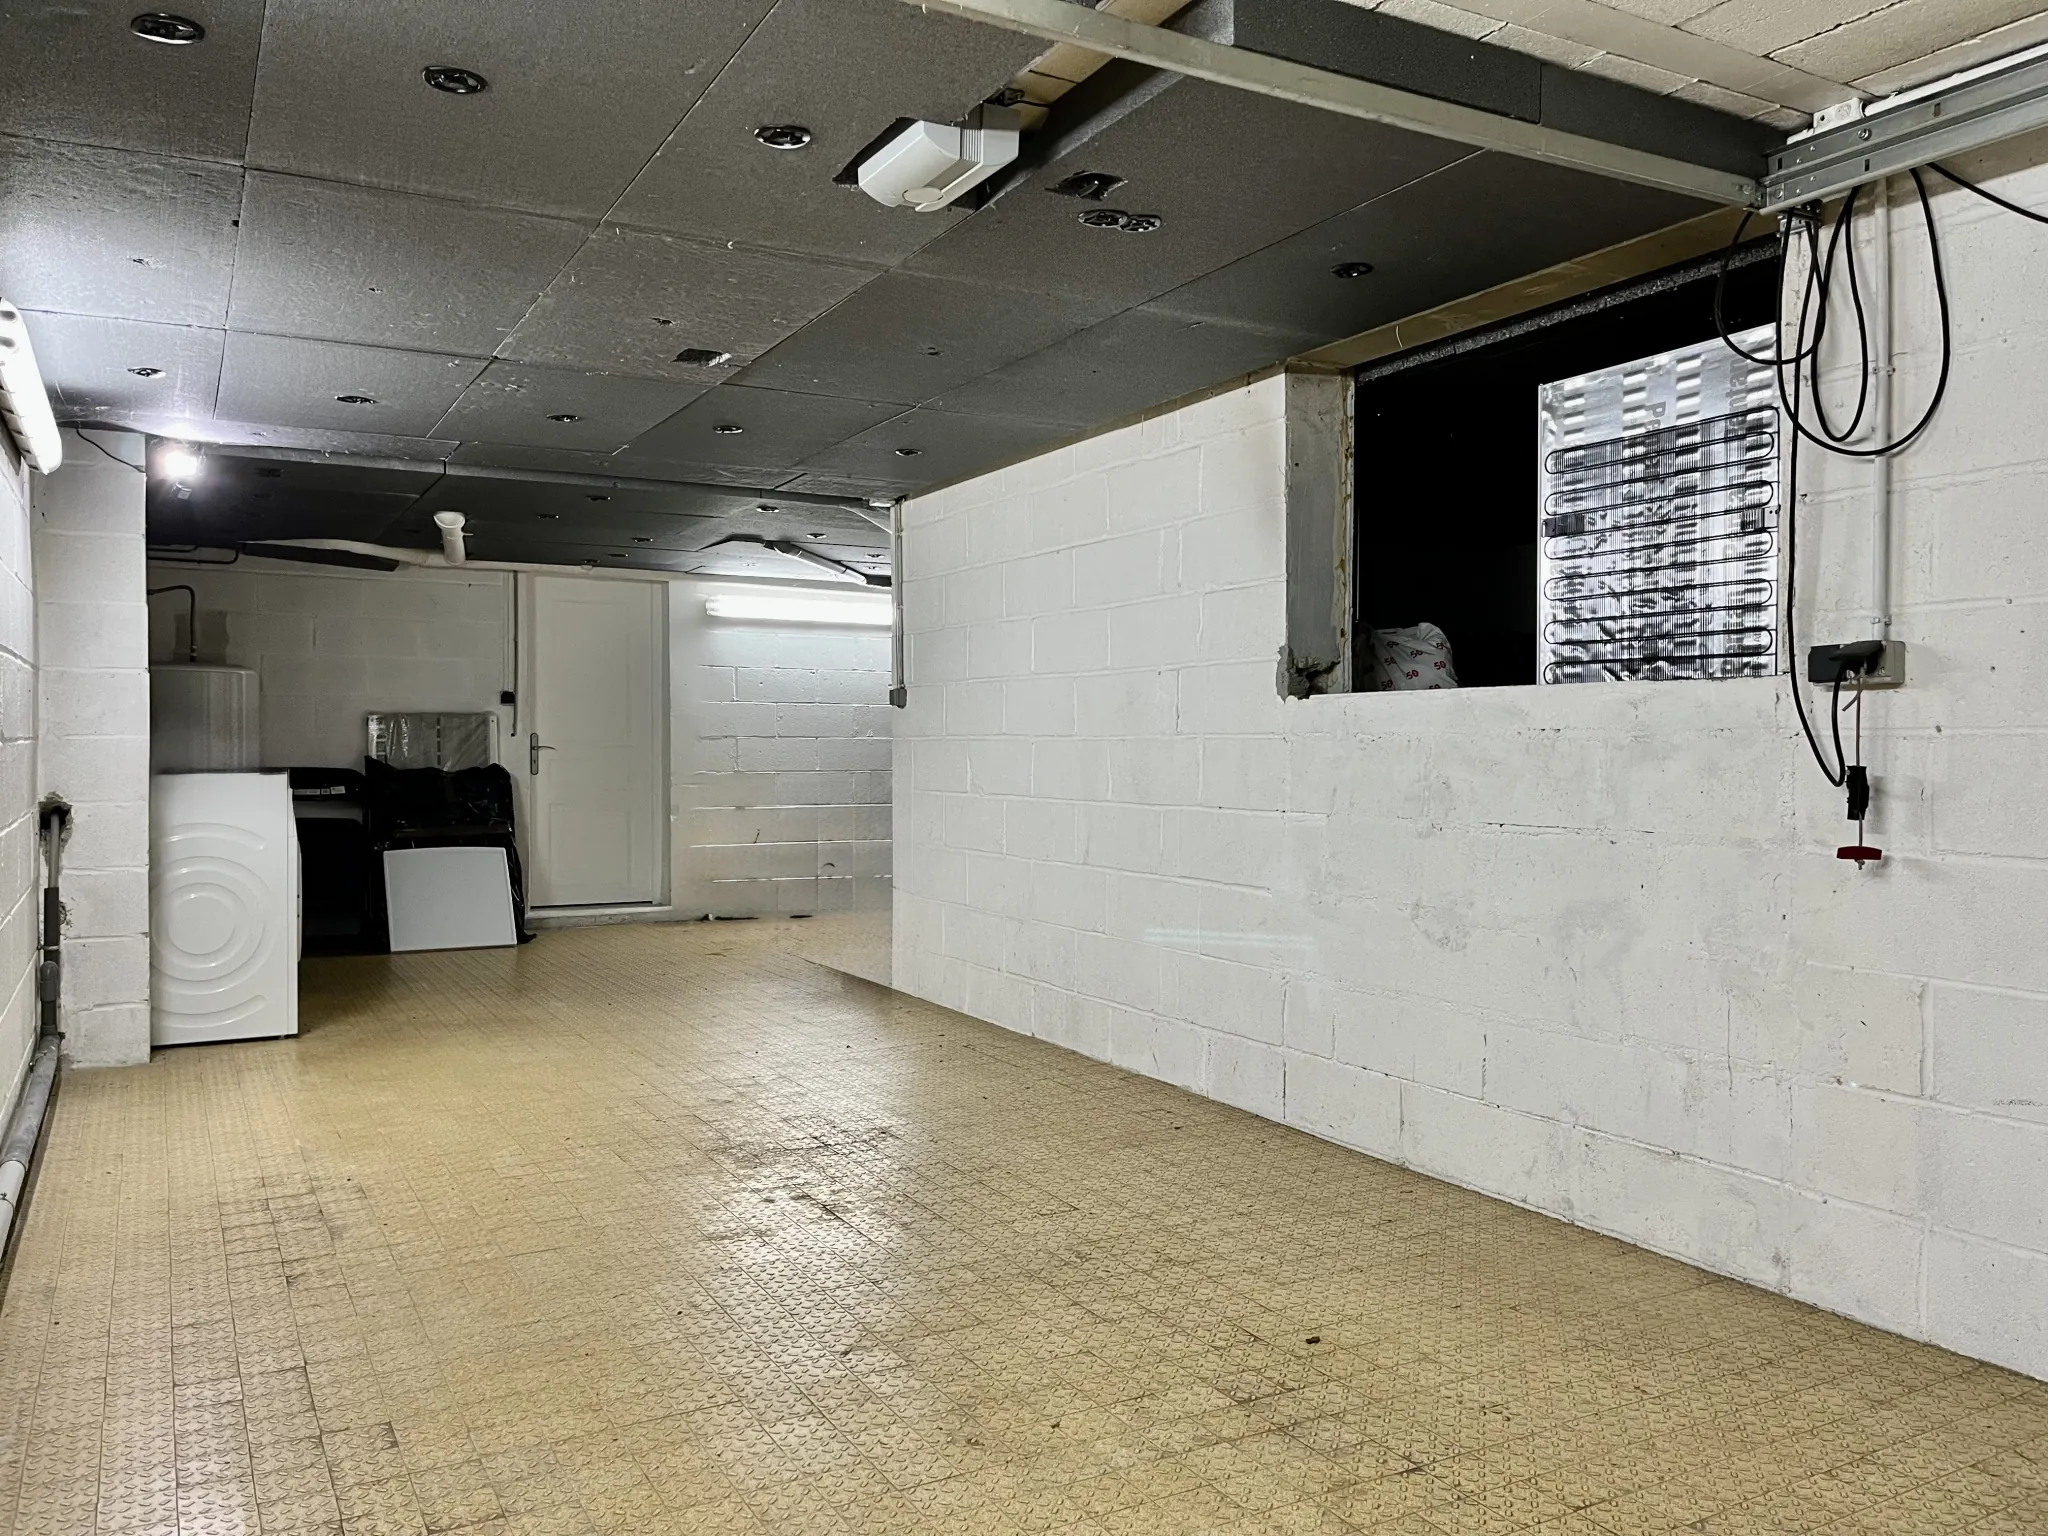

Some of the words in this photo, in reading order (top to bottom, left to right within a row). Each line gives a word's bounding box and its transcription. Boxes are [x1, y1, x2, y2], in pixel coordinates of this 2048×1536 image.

[1410, 650, 1423, 658] 50
[1384, 657, 1397, 666] 50
[1434, 661, 1446, 670] 50
[1406, 669, 1419, 680] 50
[1381, 680, 1393, 690] 50
